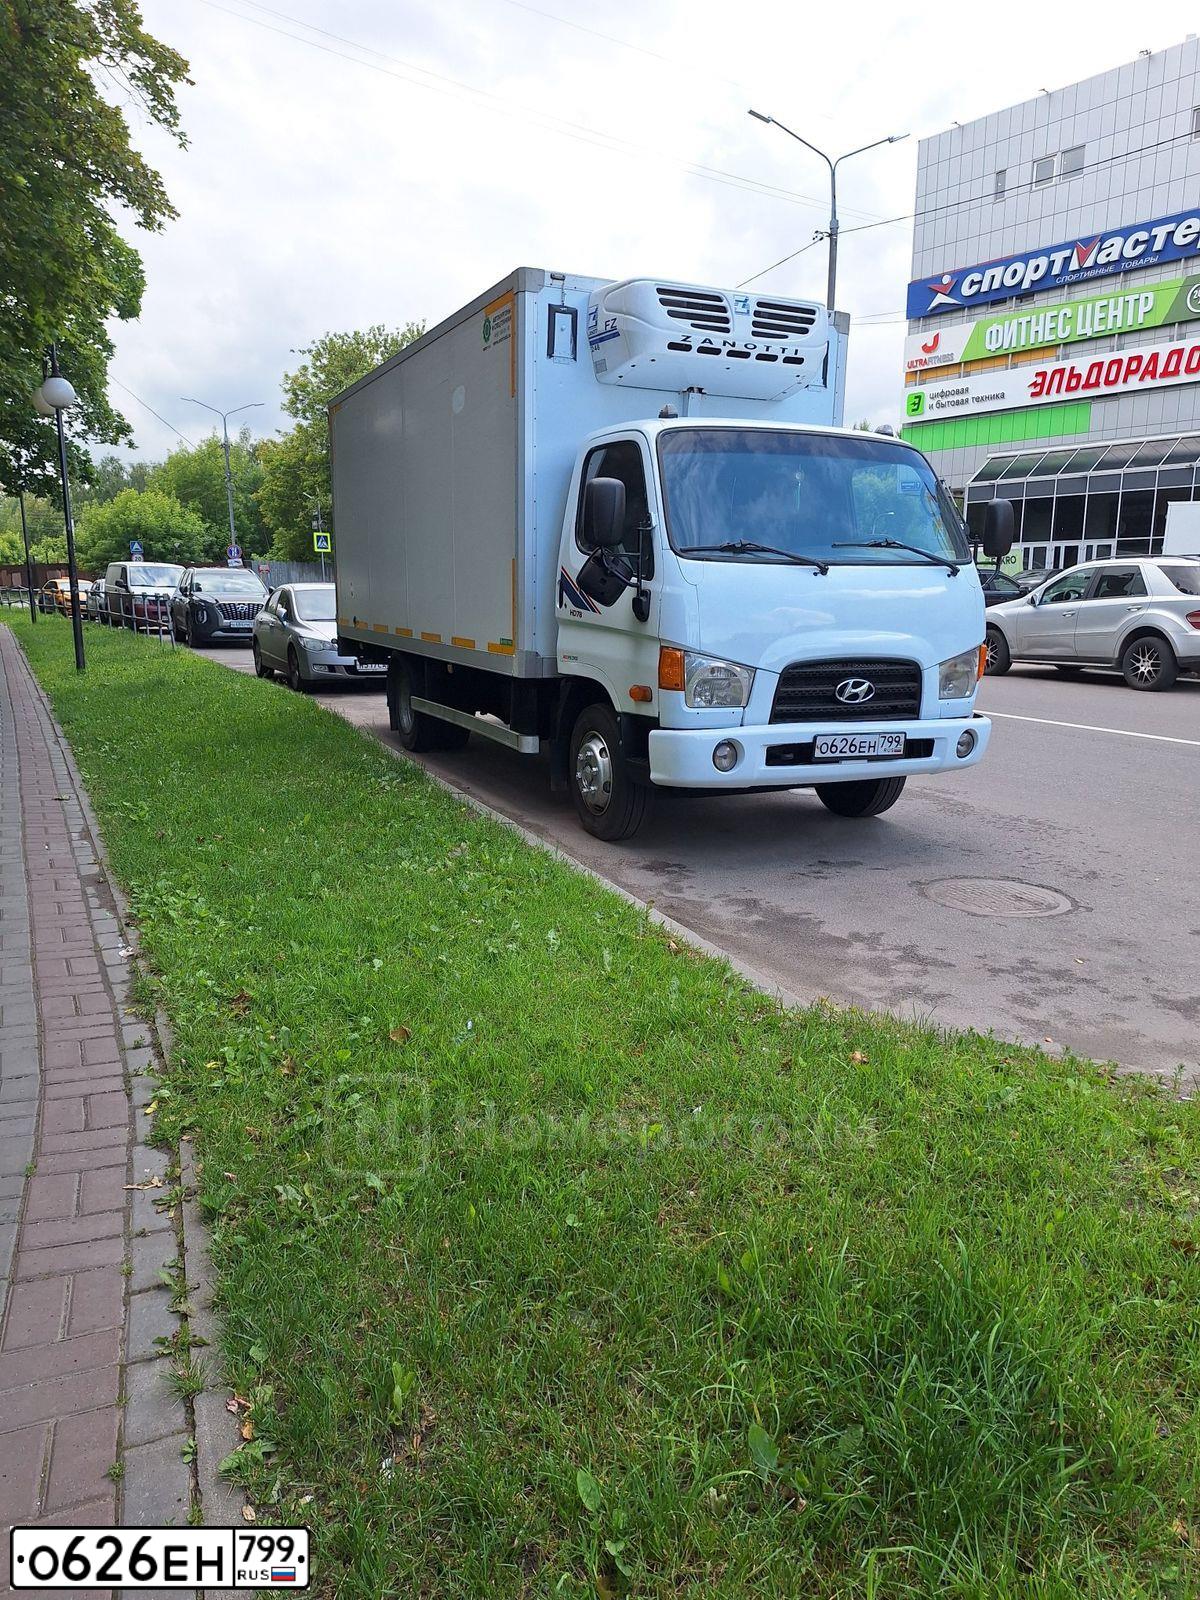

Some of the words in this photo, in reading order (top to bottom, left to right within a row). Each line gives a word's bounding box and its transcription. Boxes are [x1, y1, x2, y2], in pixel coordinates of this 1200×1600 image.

[961, 217, 1200, 297] спортМасте
[1056, 265, 1115, 284] СПОРТИВНЫЕ
[1121, 255, 1158, 269] ТОВАРЫ
[605, 317, 617, 330] FZ
[985, 308, 1072, 351] ФИТНЕС
[1077, 292, 1155, 337] ЦЕНТР
[680, 335, 799, 356] ZANOTTI
[907, 352, 954, 369] ULTRAFITNESS
[1028, 345, 1200, 397] ЭЛЬДОРАДО
[928, 402, 934, 411] и
[935, 397, 969, 410] бытовая
[971, 391, 1005, 404] техника
[929, 386, 969, 400] цифровая
[880, 735, 900, 749] 799
